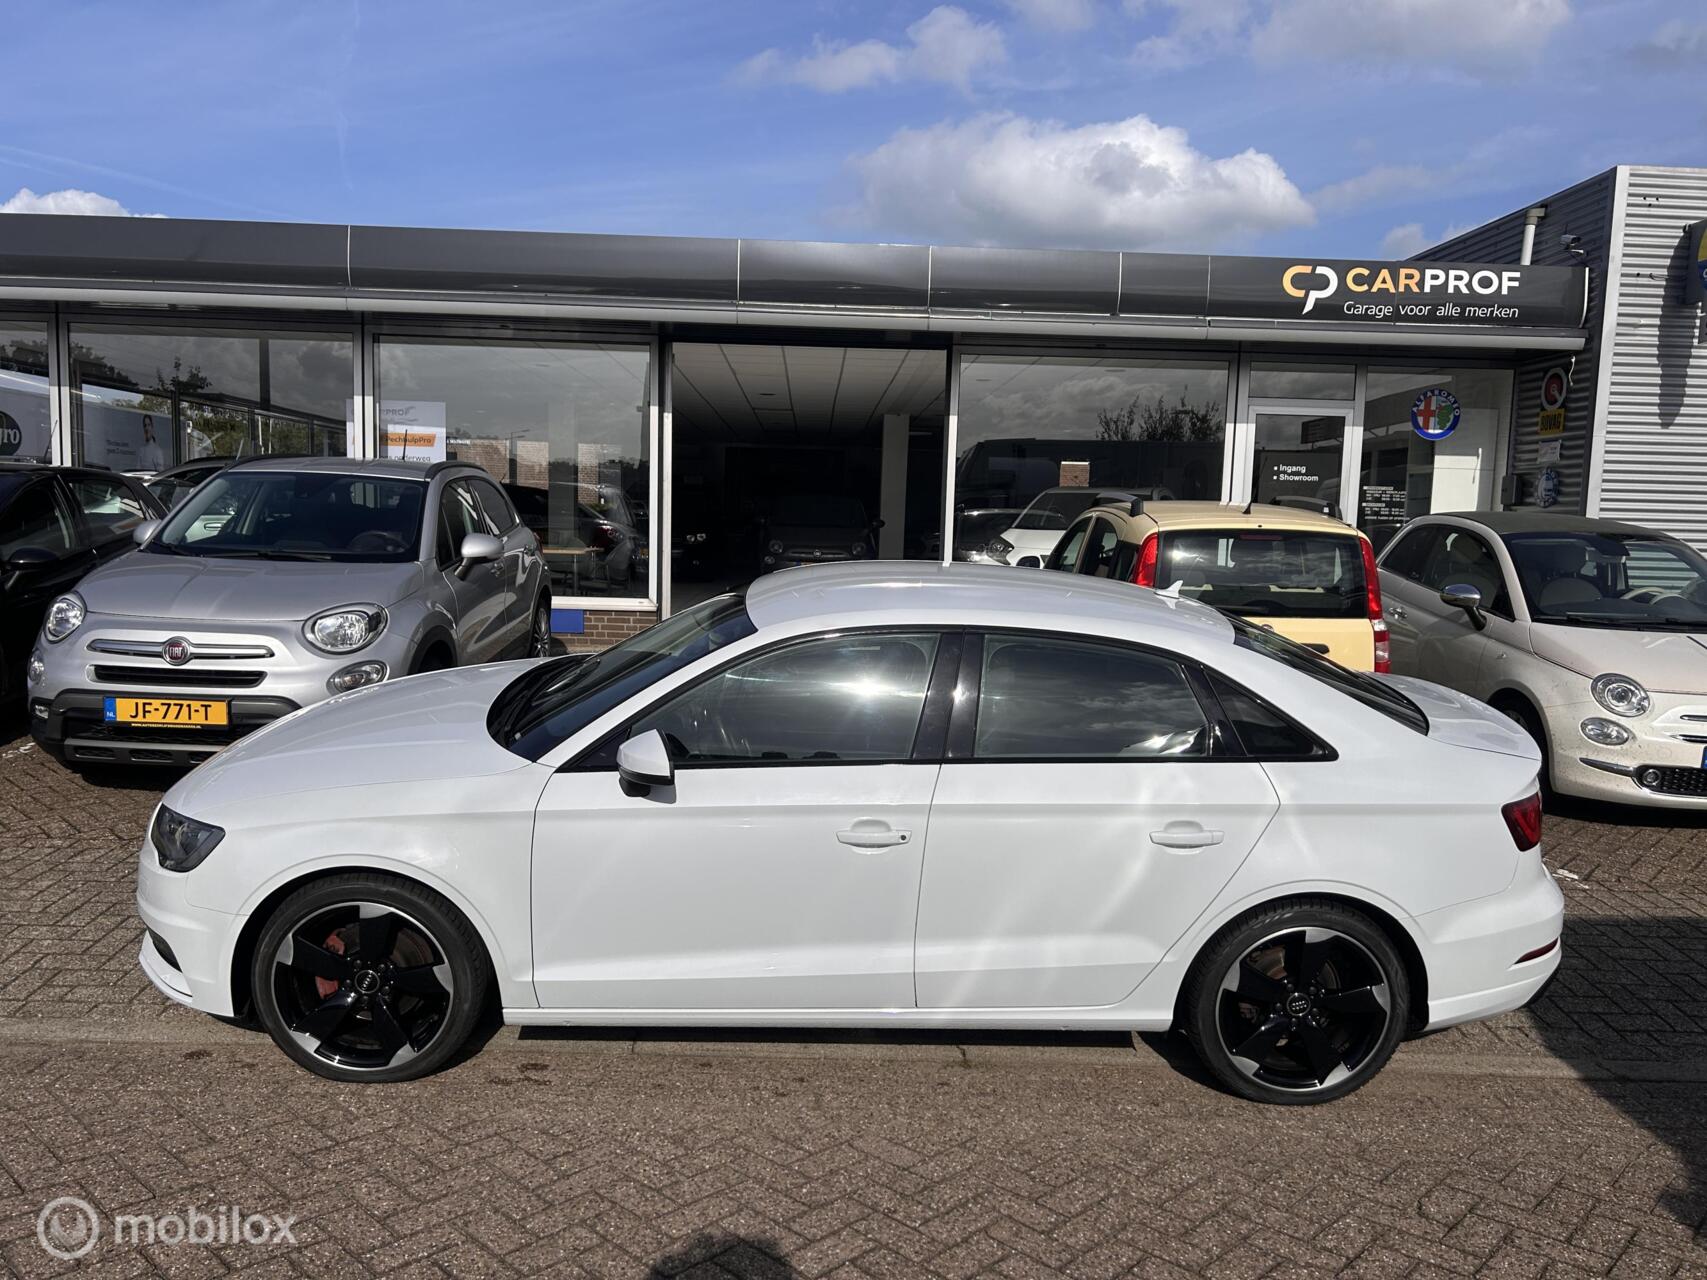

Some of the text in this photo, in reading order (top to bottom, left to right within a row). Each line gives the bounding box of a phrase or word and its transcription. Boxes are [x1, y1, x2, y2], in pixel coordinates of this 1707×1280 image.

[1345, 267, 1521, 295] CARPROF
[1343, 301, 1519, 319] Garage voor alle merken
[1279, 464, 1306, 474] Ingang
[1279, 473, 1319, 482] Showroom
[169, 646, 183, 657] FIAT
[129, 702, 212, 721] JF-771-T
